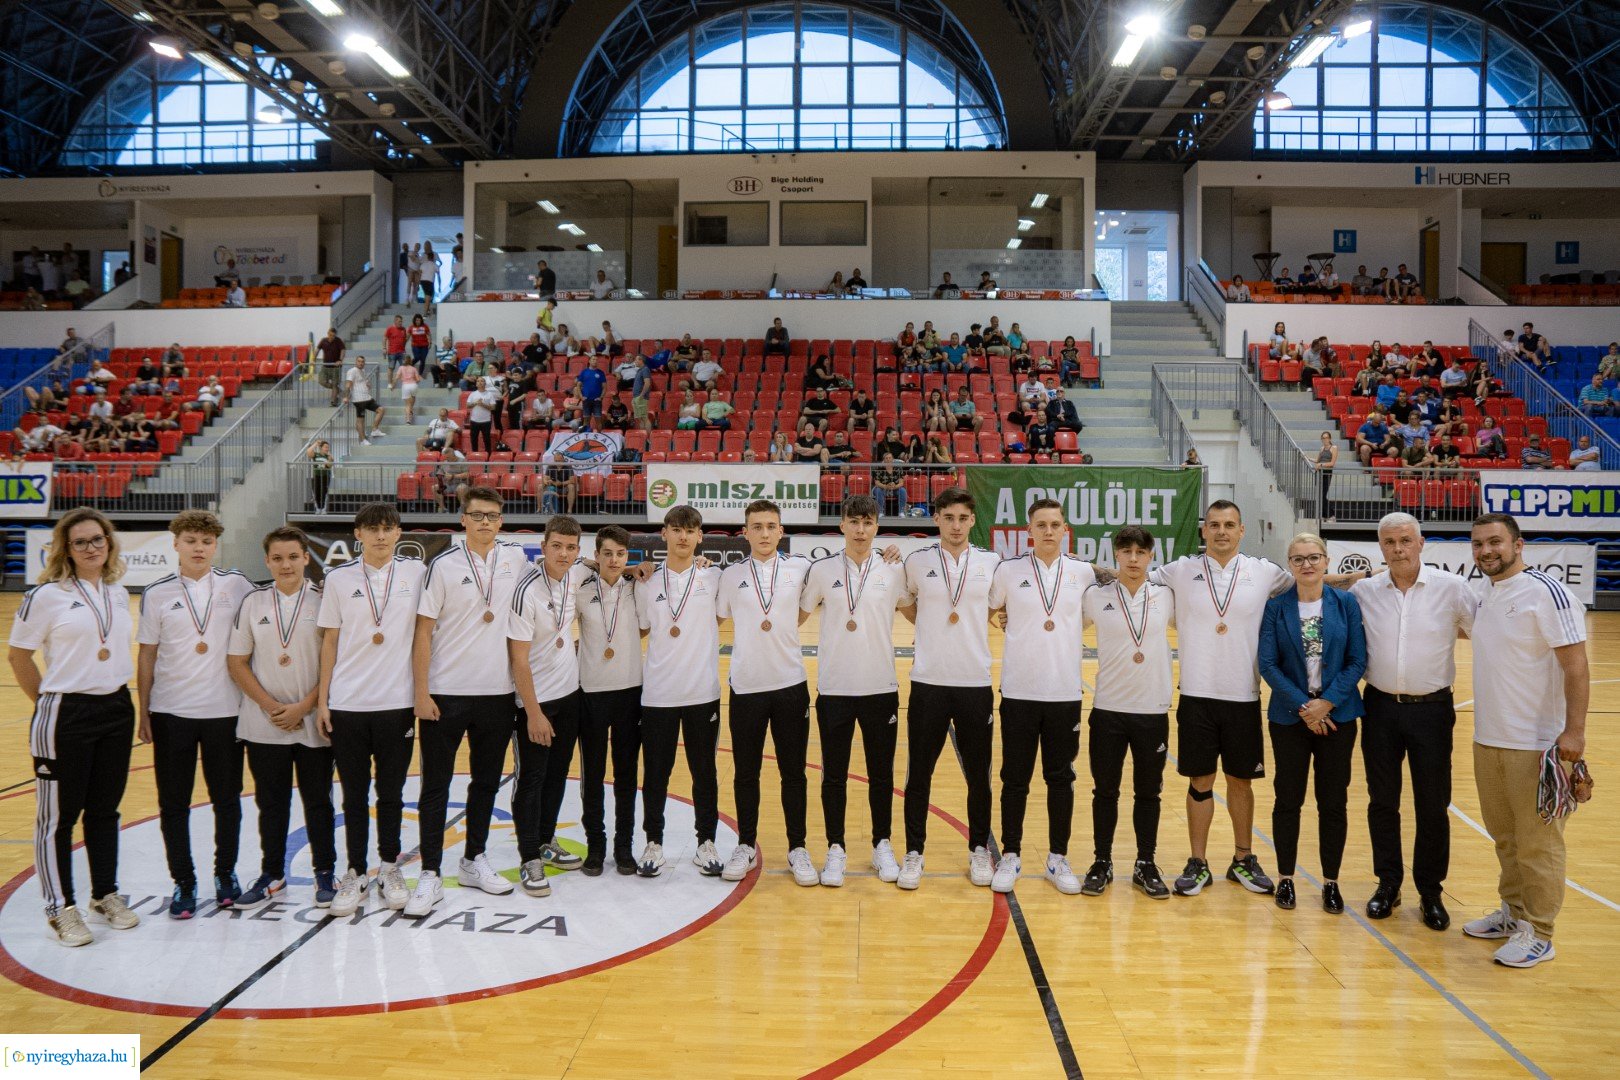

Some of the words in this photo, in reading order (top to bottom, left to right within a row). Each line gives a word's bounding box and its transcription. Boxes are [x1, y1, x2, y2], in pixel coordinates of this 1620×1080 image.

[734, 180, 756, 192] BH
[771, 176, 789, 184] Bige
[792, 176, 824, 184] Holding
[1438, 172, 1510, 186] HÜBNER
[565, 433, 614, 449] FUTSAL
[0, 478, 46, 500] IX
[687, 480, 818, 500] mlsz.hu
[687, 500, 719, 509] Magyar
[995, 487, 1017, 525] A
[1486, 486, 1620, 515] TiPPMI
[993, 530, 1071, 559] NE
[1078, 532, 1175, 571] PÁA!
